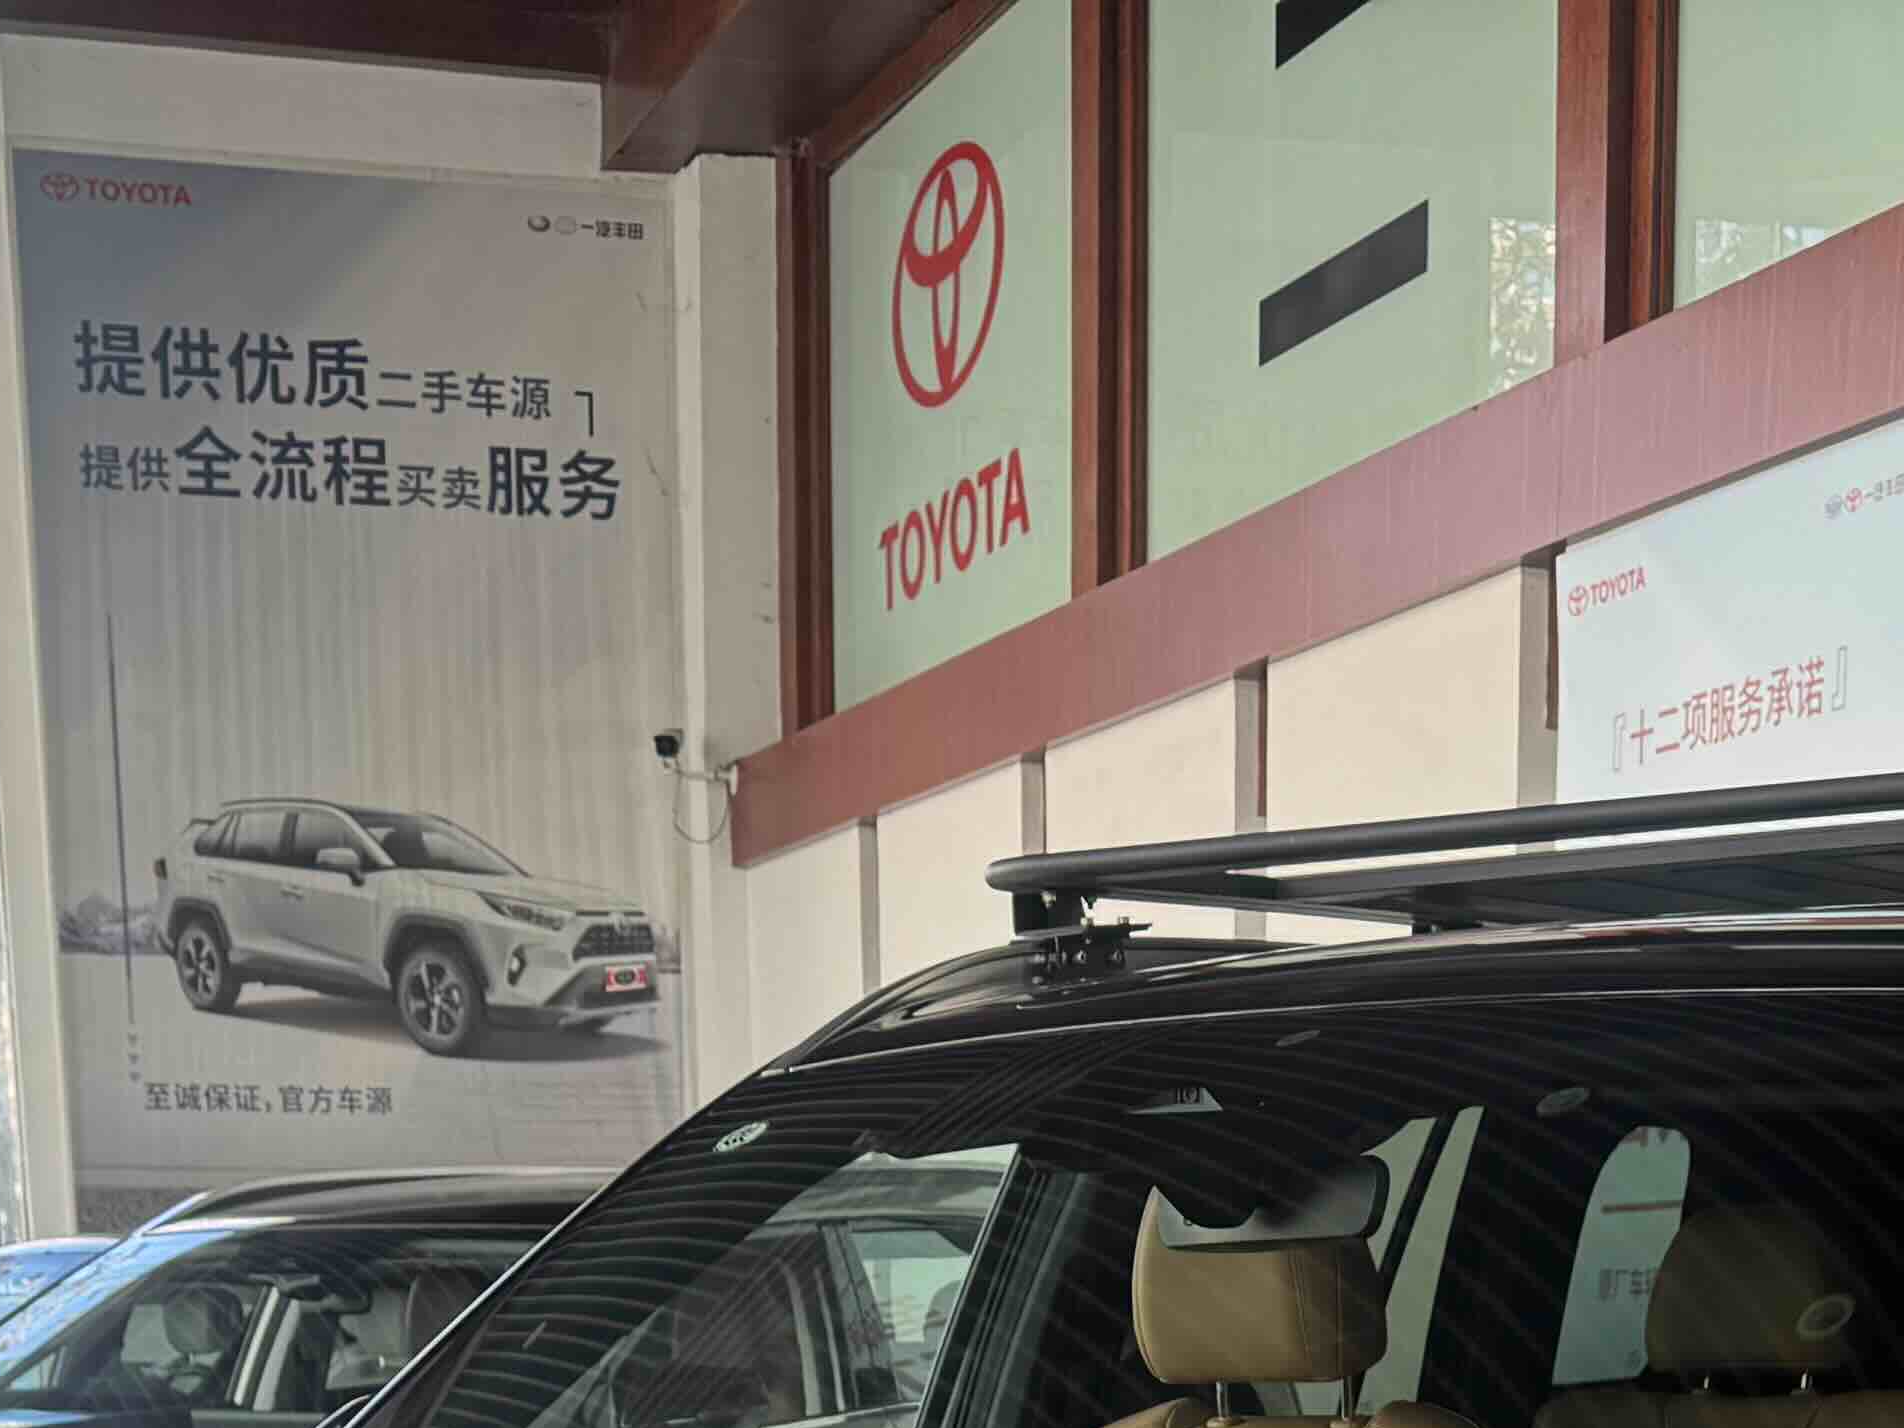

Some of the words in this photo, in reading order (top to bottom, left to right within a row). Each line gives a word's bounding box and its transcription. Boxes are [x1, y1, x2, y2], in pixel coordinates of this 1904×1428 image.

[87, 176, 192, 206] TOYOTA
[74, 319, 552, 423] 提供优质二手车源
[79, 425, 622, 523] 提供全流程买卖服务
[878, 447, 1031, 612] TOYOTA
[1589, 566, 1647, 608] TOYOTA
[143, 1081, 394, 1115] 至诚保证，官方车源
